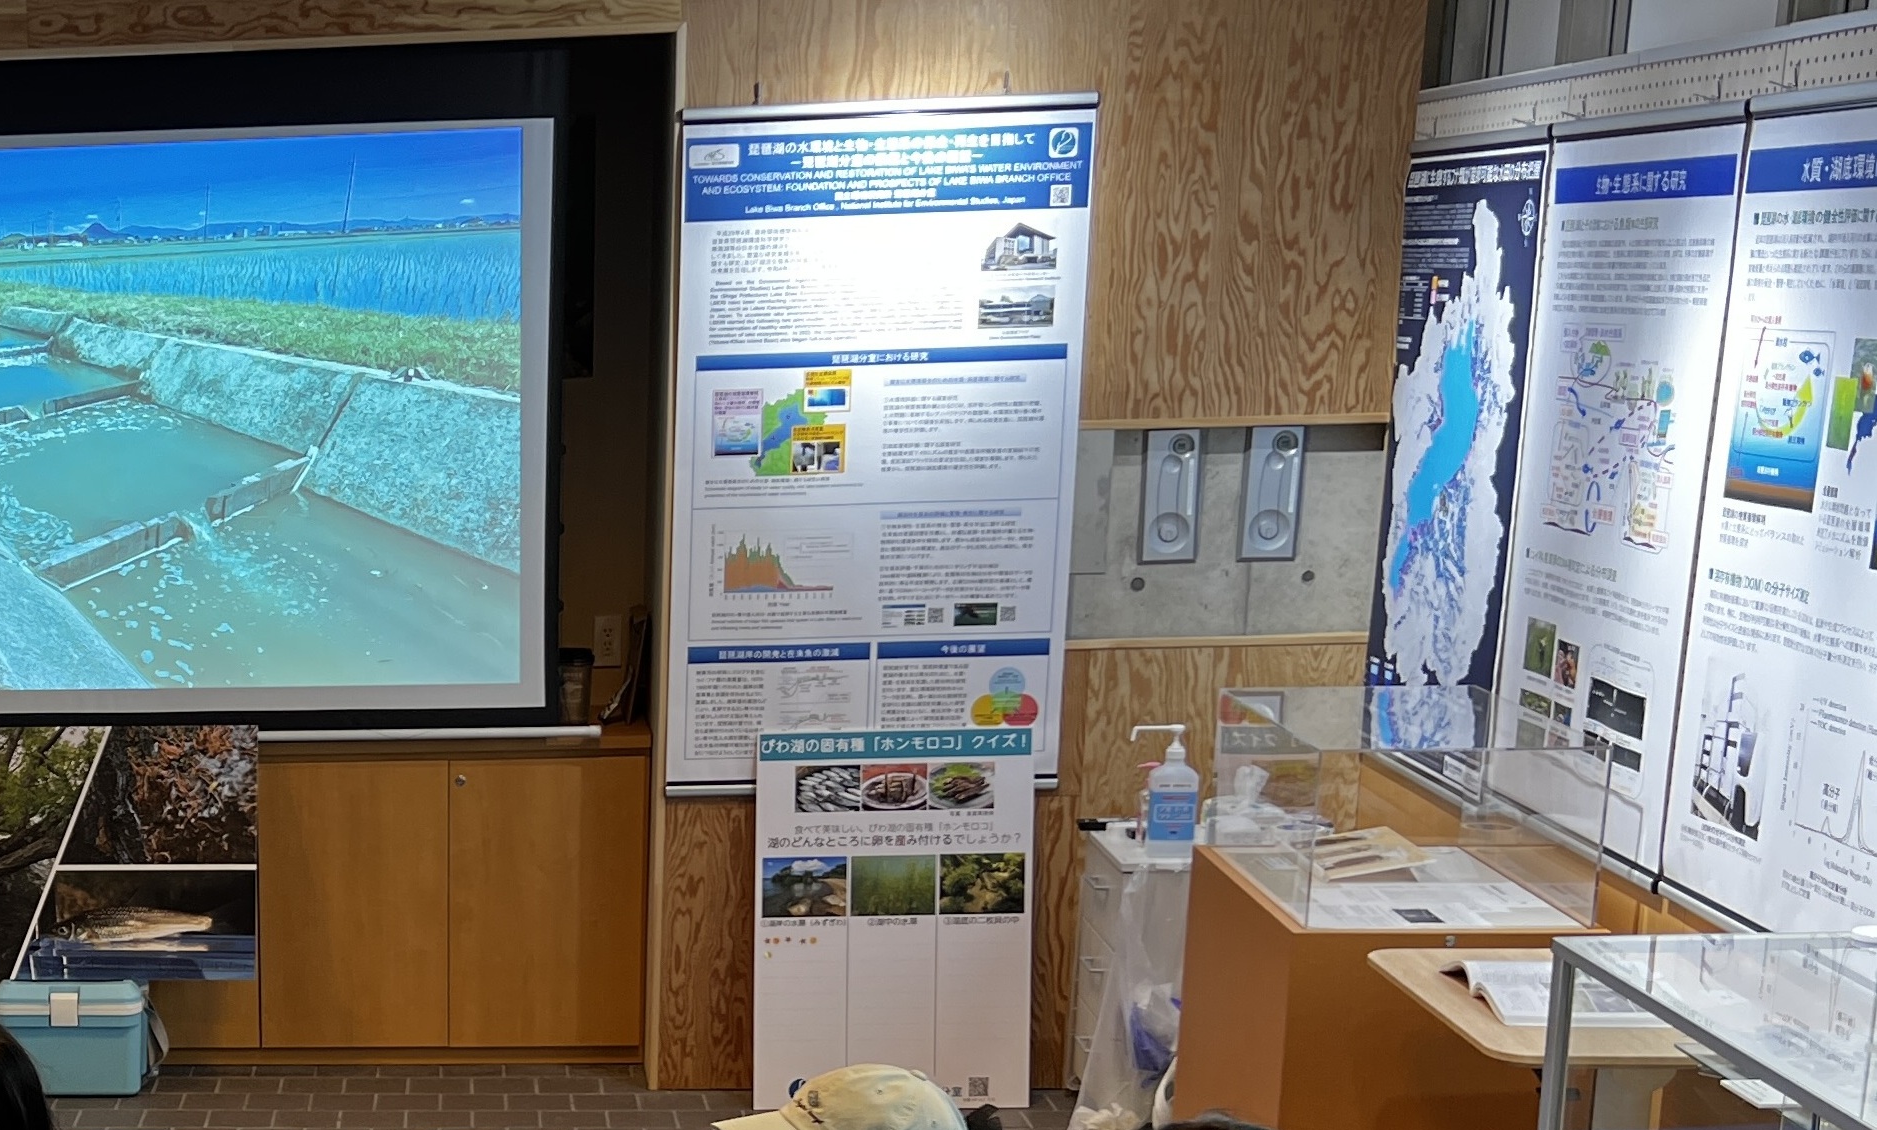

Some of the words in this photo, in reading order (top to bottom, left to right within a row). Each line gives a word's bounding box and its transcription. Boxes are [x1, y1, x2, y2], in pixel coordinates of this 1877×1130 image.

[693, 174, 738, 184] TOWARDS
[740, 171, 812, 183] CONSERVATION
[814, 170, 833, 180] AND
[1014, 160, 1083, 171] ENVIRONMENT
[1800, 153, 1877, 183] 水質・湖底環境
[702, 186, 721, 195] AND
[786, 181, 845, 191] FOUNDATION
[995, 173, 1035, 183] BRANCH
[1037, 172, 1072, 182] OFFICE
[767, 832, 1022, 849] 湖のどんなところに卵を産み付けるでしょうか？
